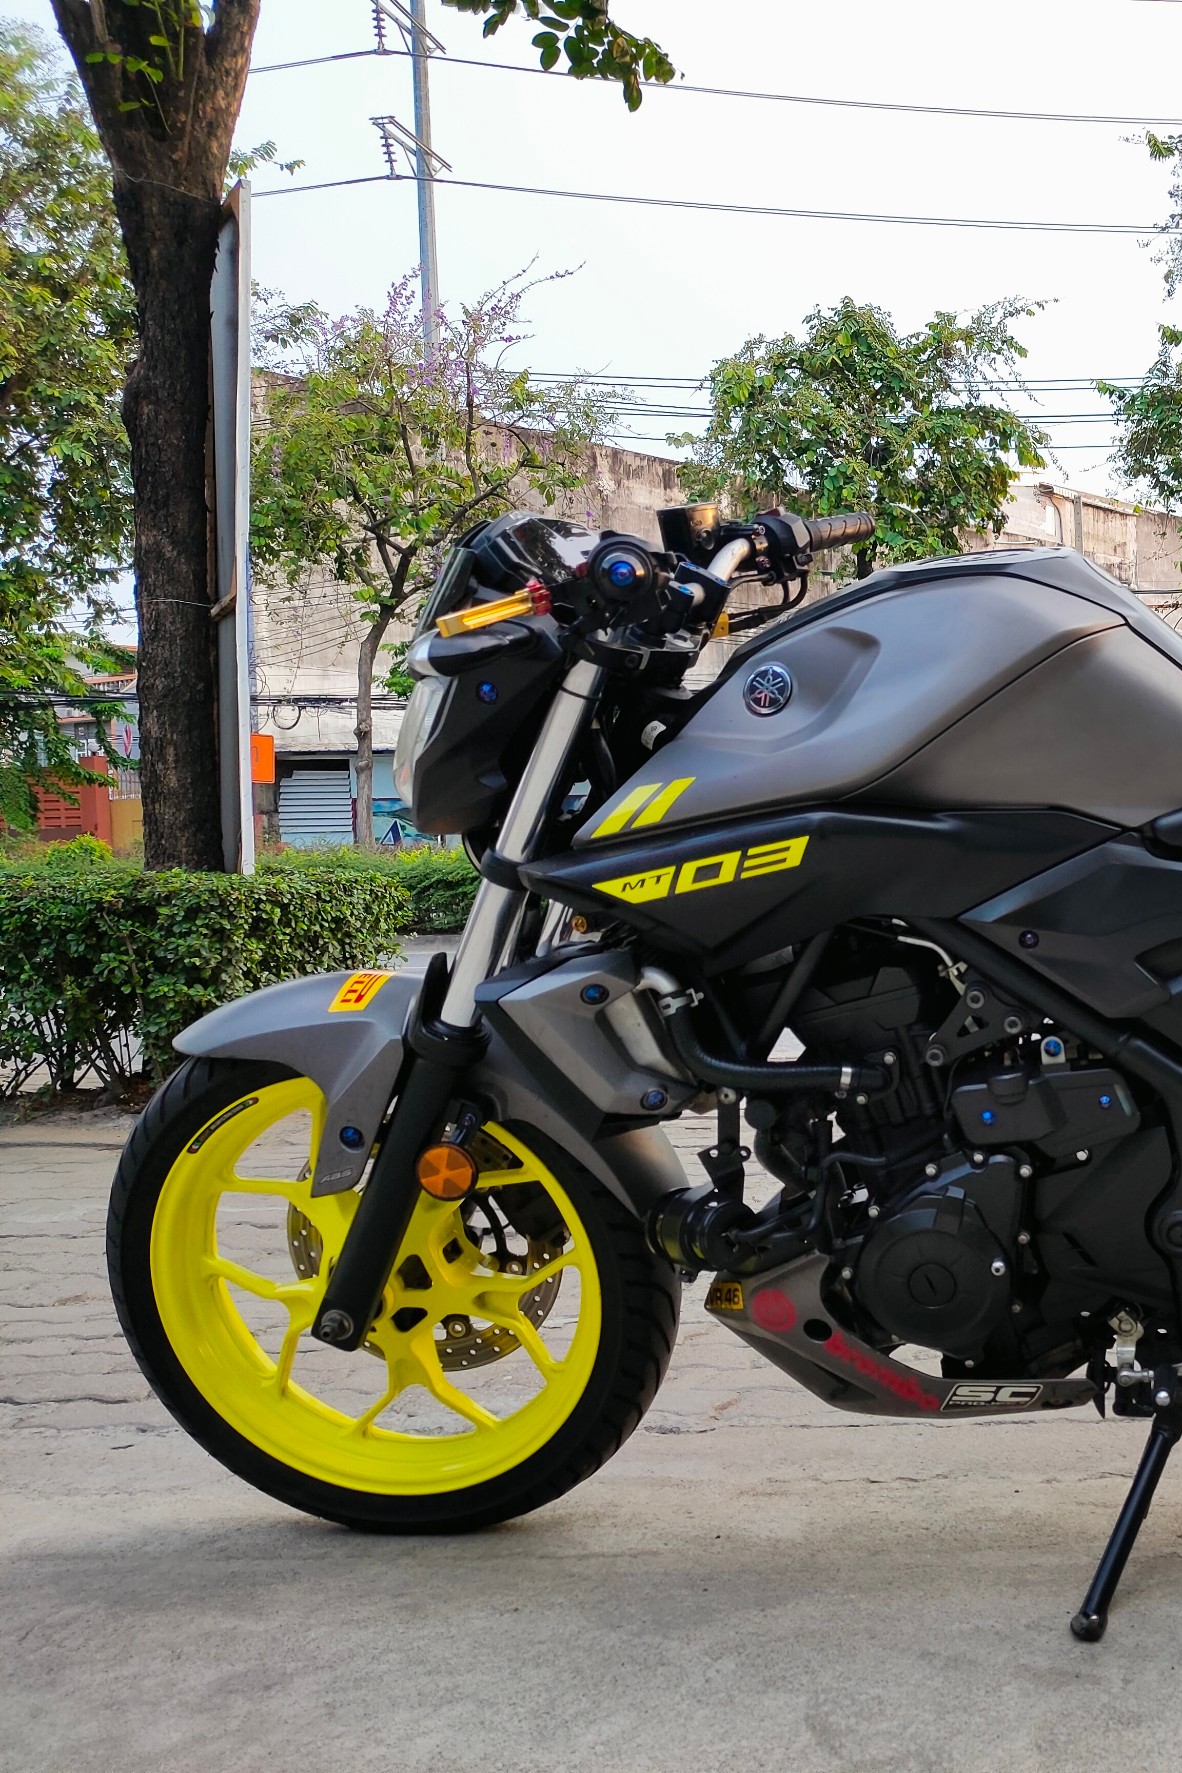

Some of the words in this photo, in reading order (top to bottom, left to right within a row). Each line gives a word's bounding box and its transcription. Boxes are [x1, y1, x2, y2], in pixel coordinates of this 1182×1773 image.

[620, 872, 670, 893] MT
[675, 835, 810, 895] 03
[320, 1168, 352, 1184] ABS
[951, 1386, 1038, 1402] SC
